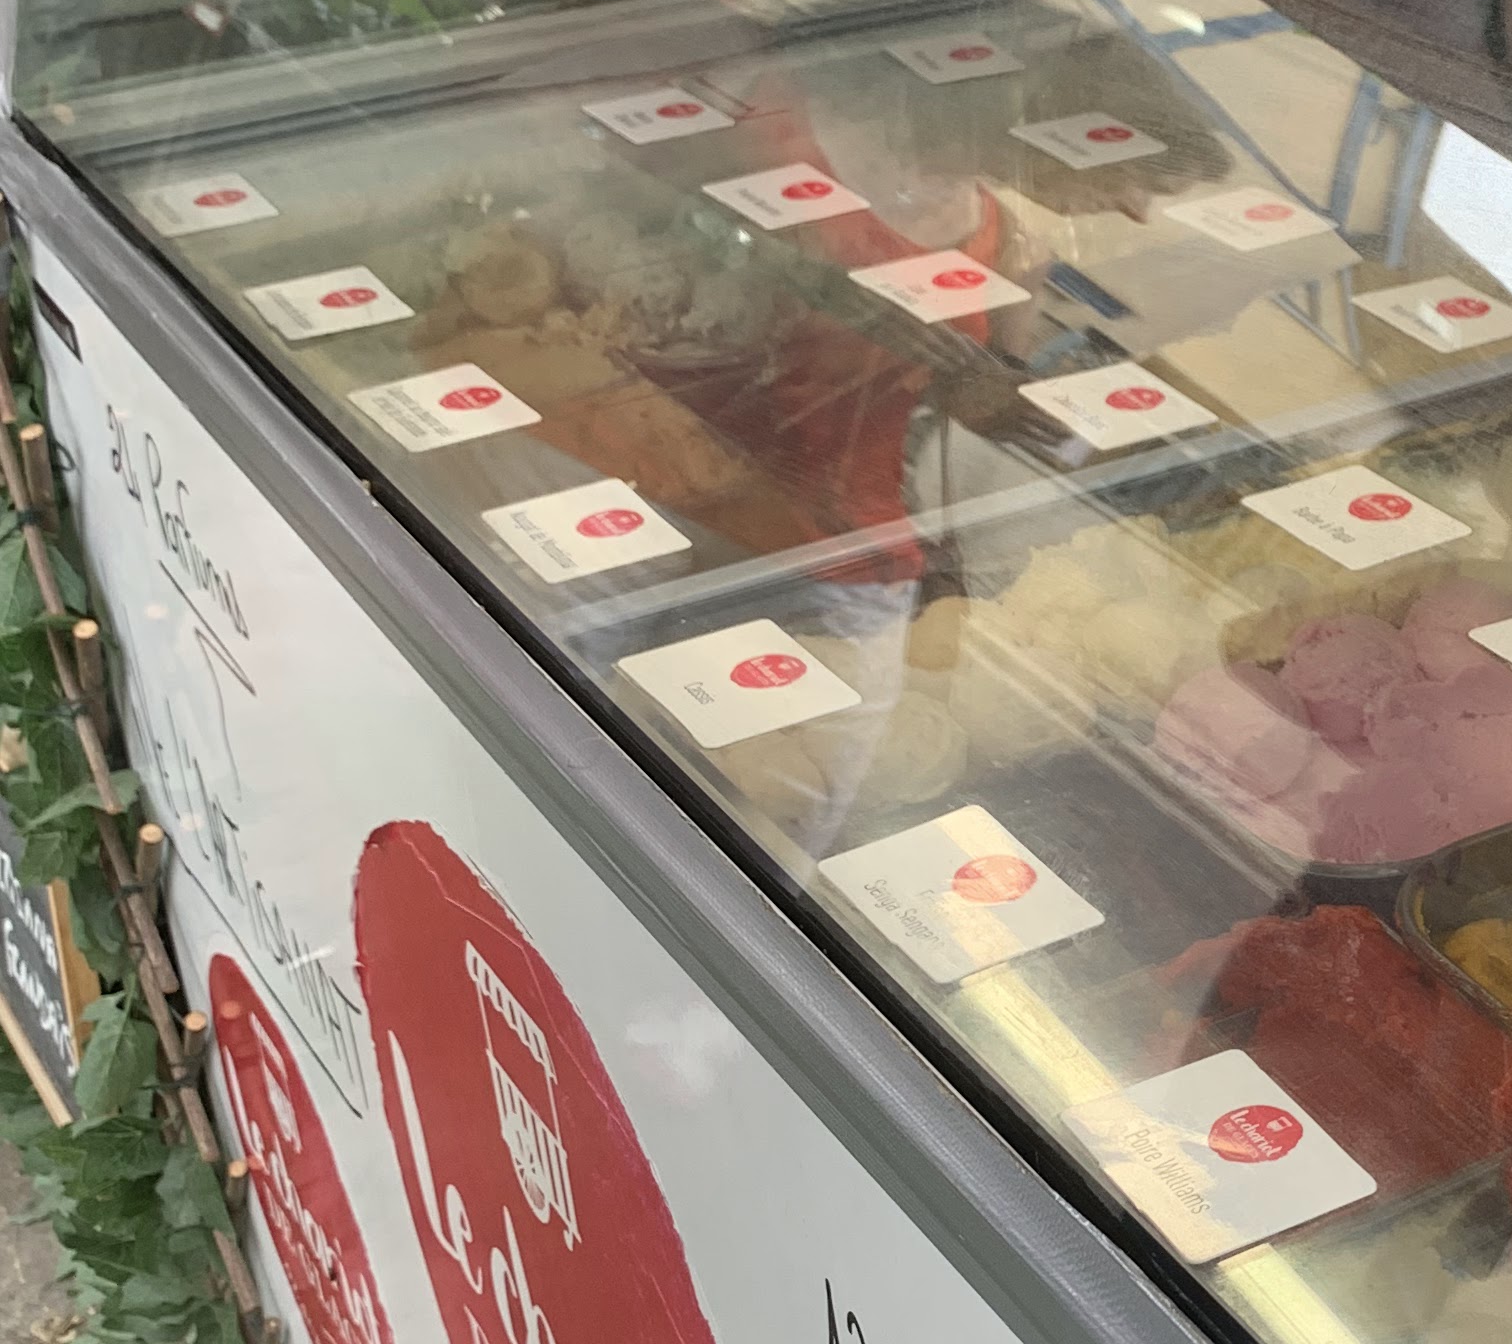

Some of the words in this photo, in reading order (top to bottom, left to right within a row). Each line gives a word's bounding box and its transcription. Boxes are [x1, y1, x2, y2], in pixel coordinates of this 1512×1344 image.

[388, 1031, 482, 1299] Le
[1124, 1128, 1163, 1164] Poire
[1151, 1157, 1211, 1217] Williams
